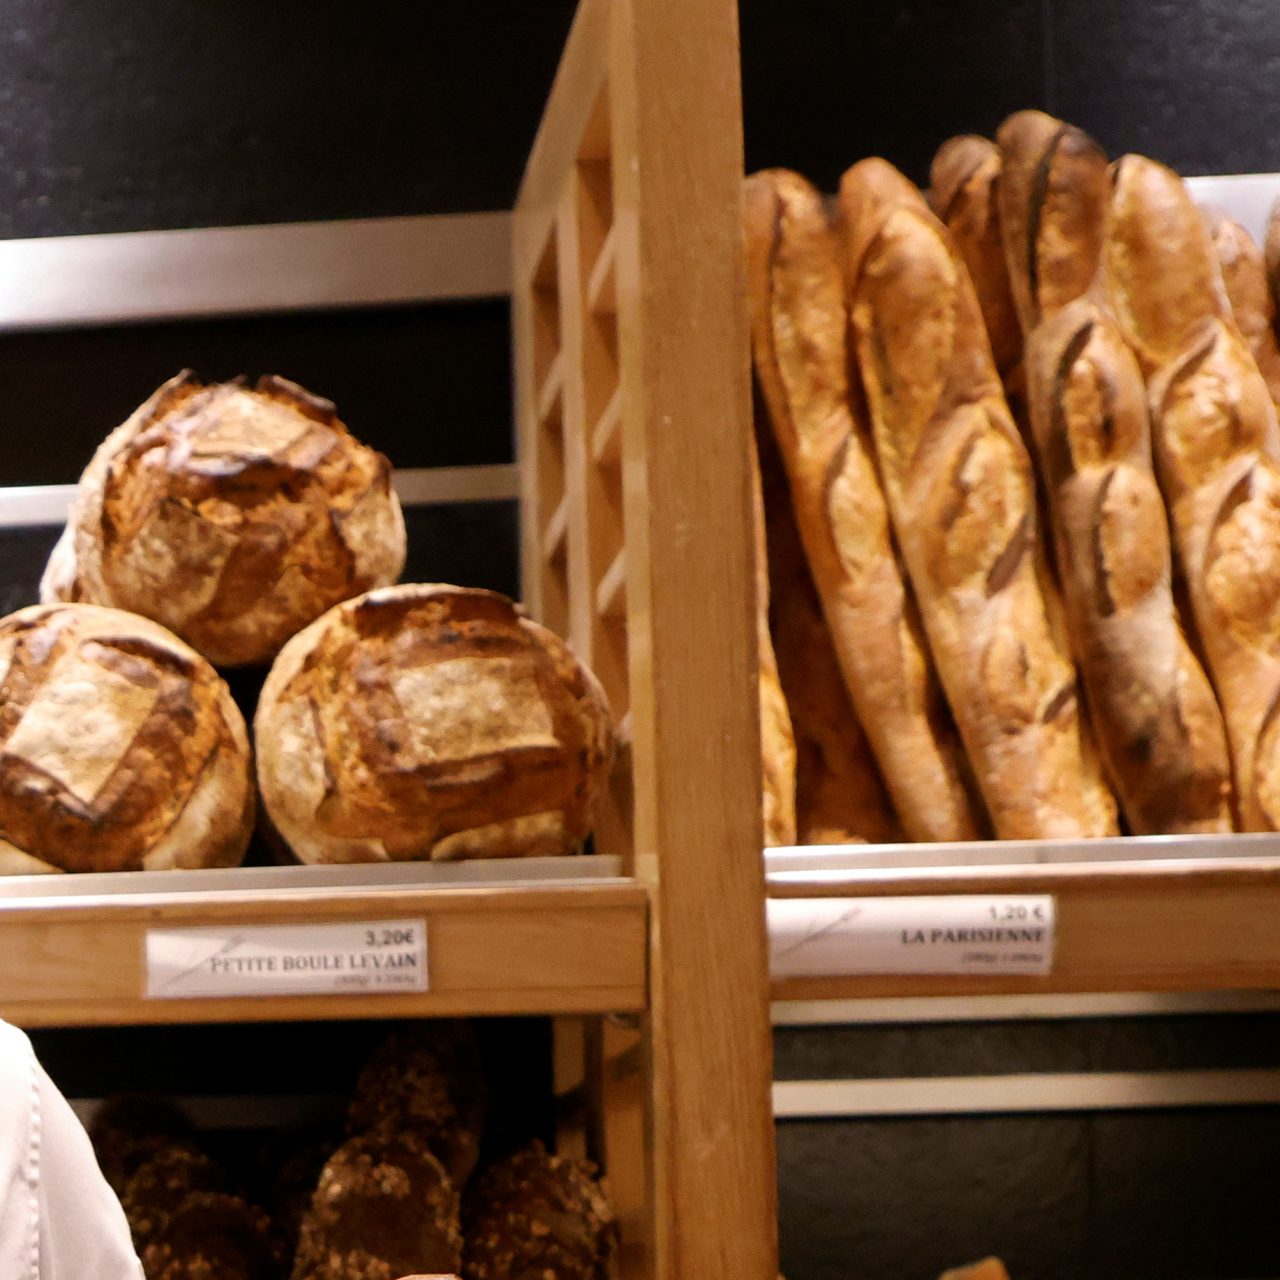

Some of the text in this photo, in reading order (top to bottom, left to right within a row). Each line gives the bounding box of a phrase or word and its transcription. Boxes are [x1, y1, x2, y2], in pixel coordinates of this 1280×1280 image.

[901, 927, 1044, 944] LA PARISIENNE
[211, 952, 417, 972] PETITE BOULE LEVAIN
